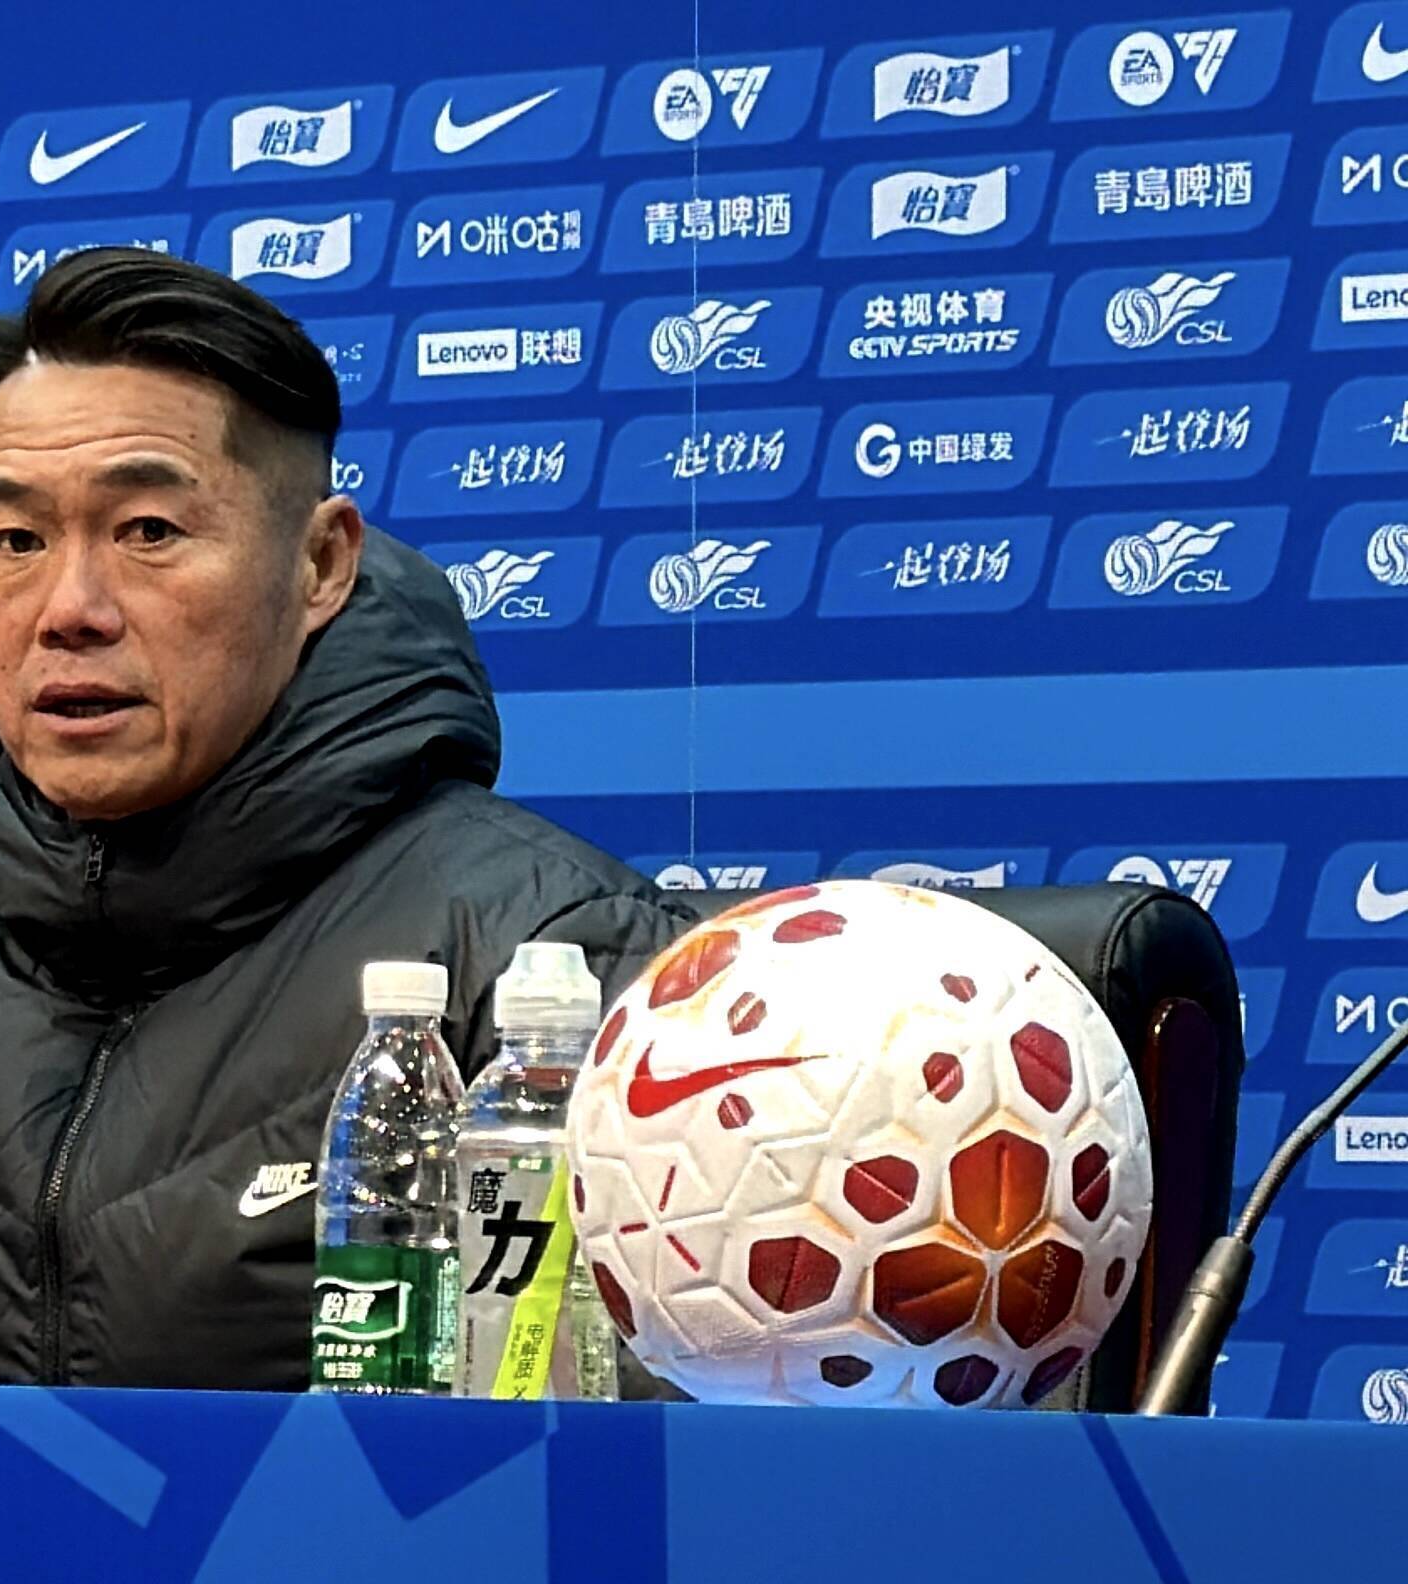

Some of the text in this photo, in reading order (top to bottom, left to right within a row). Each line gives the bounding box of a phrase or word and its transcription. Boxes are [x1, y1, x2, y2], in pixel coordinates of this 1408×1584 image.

[1122, 48, 1161, 73] EA
[863, 288, 1006, 331] 央视体育
[1175, 319, 1233, 345] CSL
[427, 327, 582, 365] Lenovo 联想
[714, 345, 767, 371] CSL
[908, 431, 1014, 465] 中国绿发
[1174, 569, 1232, 592] CSL
[500, 596, 550, 619] CSL
[714, 587, 766, 610] CSL
[253, 1162, 312, 1195] NIKE
